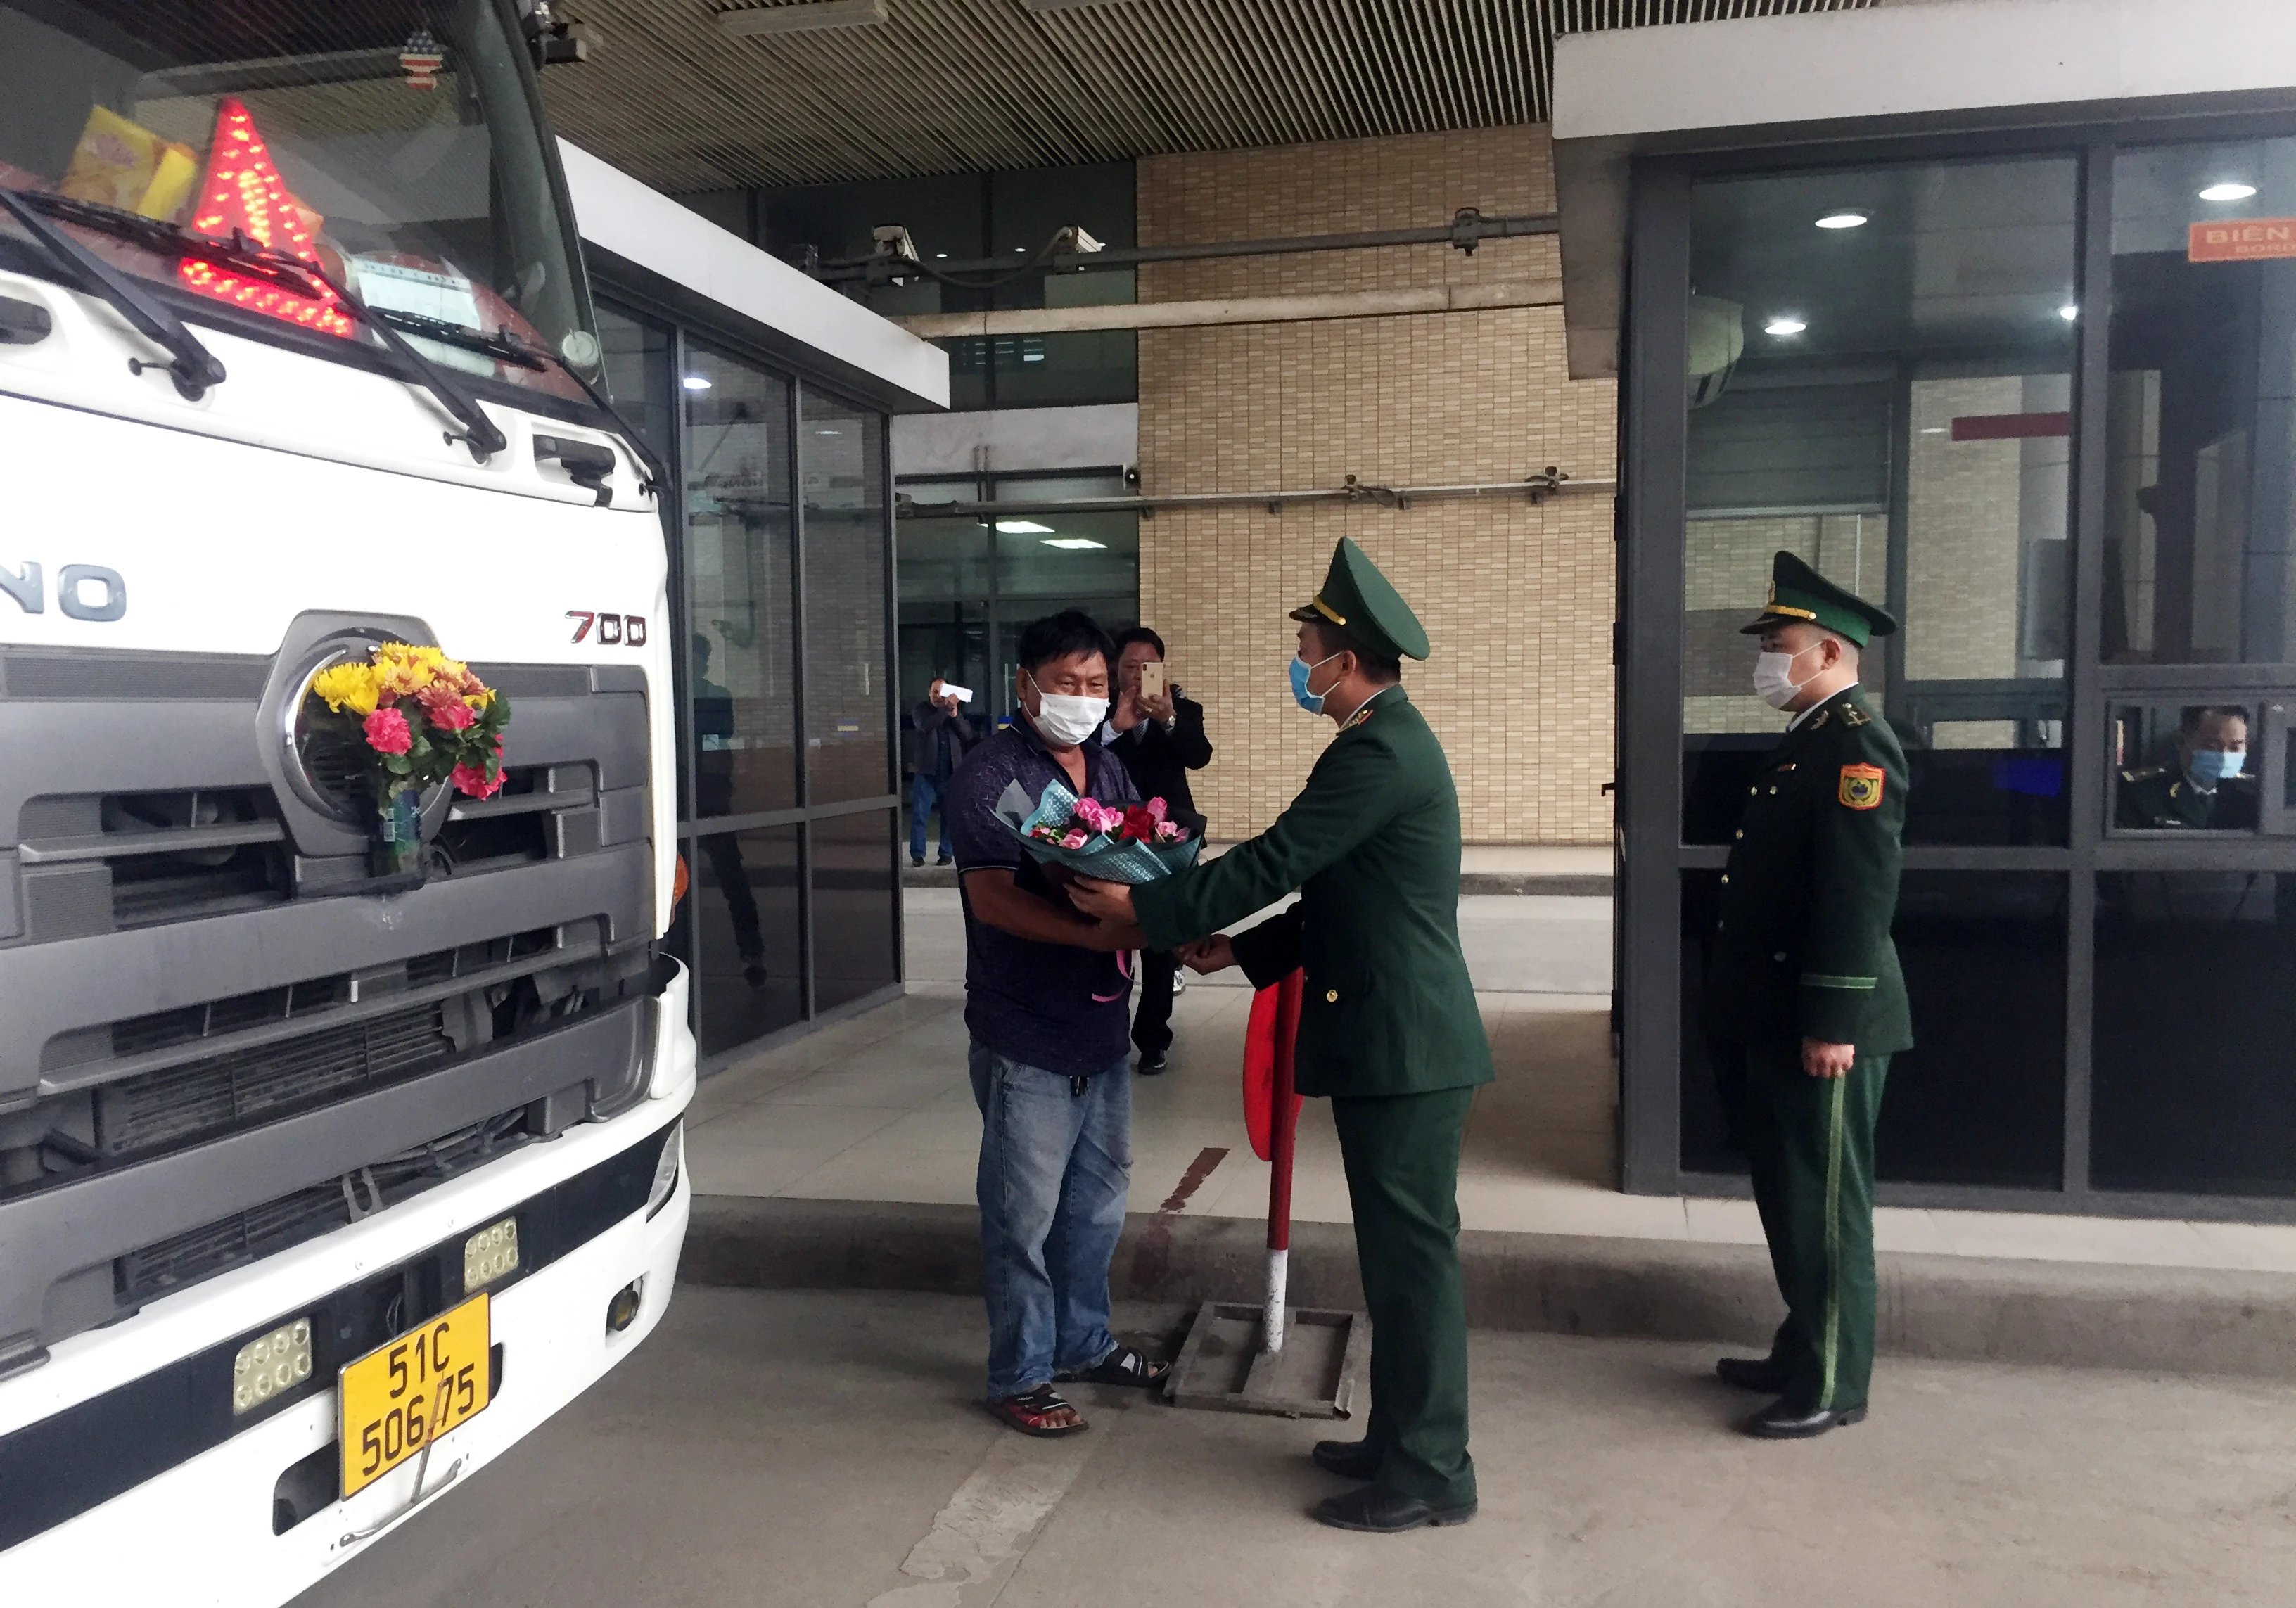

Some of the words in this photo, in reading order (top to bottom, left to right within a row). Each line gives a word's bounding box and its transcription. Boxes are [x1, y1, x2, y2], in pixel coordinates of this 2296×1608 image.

[565, 611, 646, 647] 700
[388, 1322, 449, 1399] 51C
[362, 1363, 475, 1476] 50675
